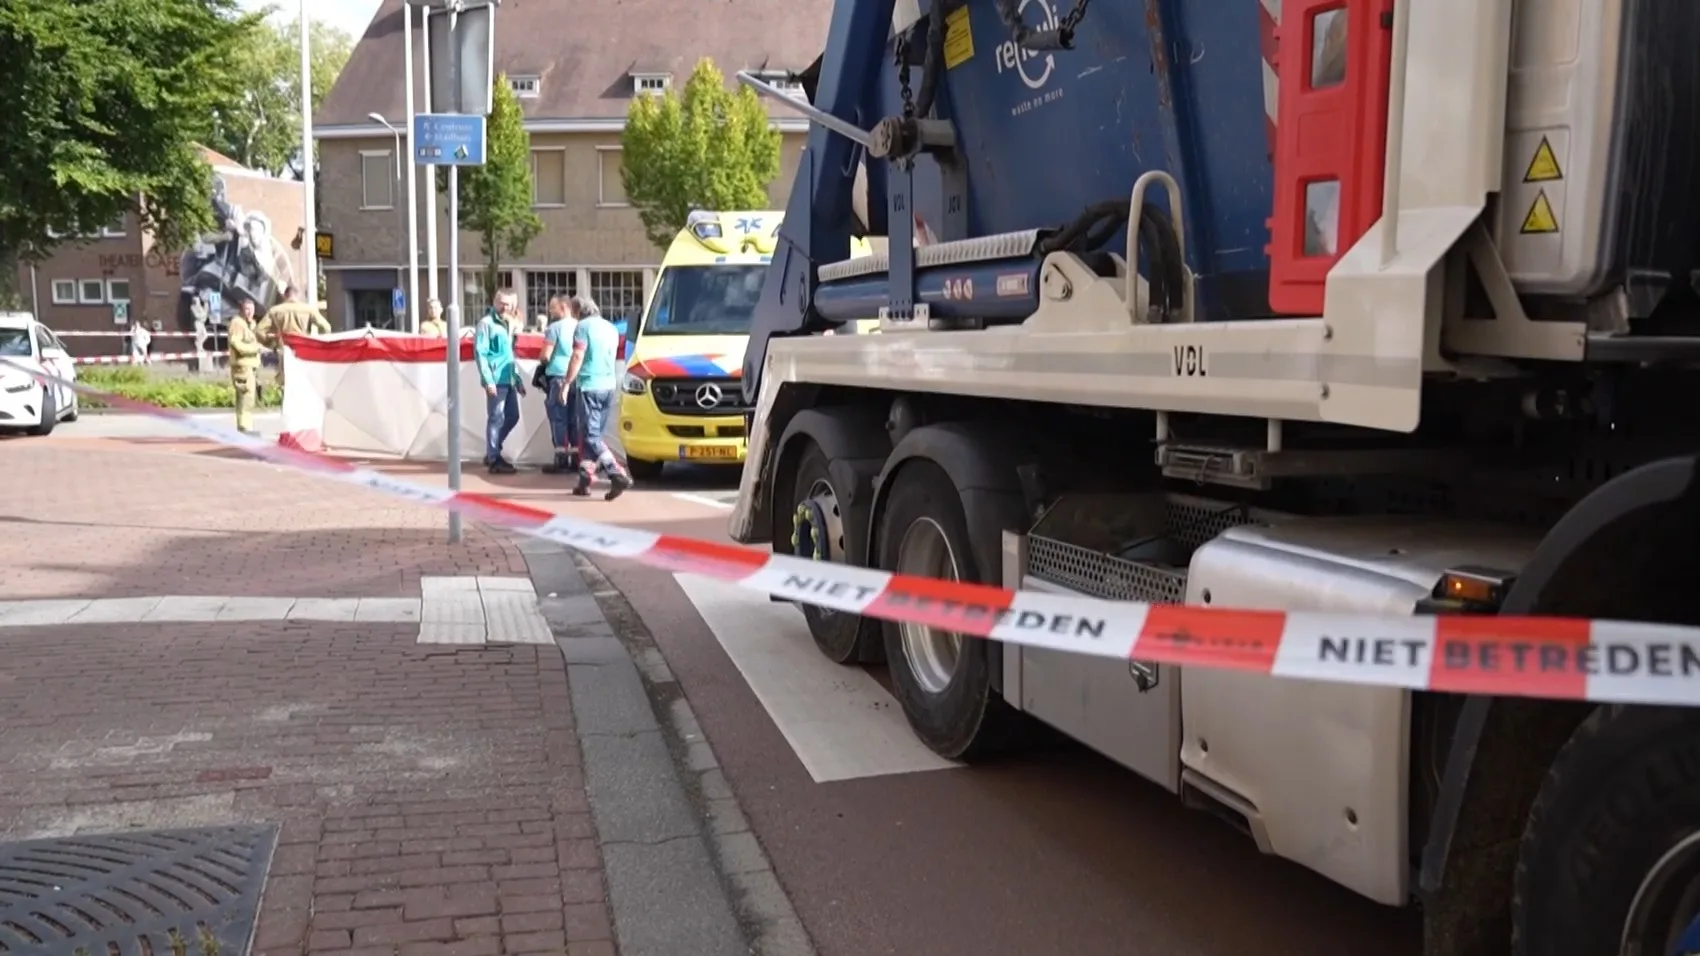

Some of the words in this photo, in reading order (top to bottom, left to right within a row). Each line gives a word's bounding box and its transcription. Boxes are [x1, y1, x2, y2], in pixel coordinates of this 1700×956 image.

[1011, 101, 1032, 116] waste
[1044, 87, 1064, 103] more
[1174, 344, 1206, 377] VDL
[783, 574, 877, 602] NIET
[884, 589, 1106, 638] BETREDEN
[1318, 636, 1426, 668] NIET
